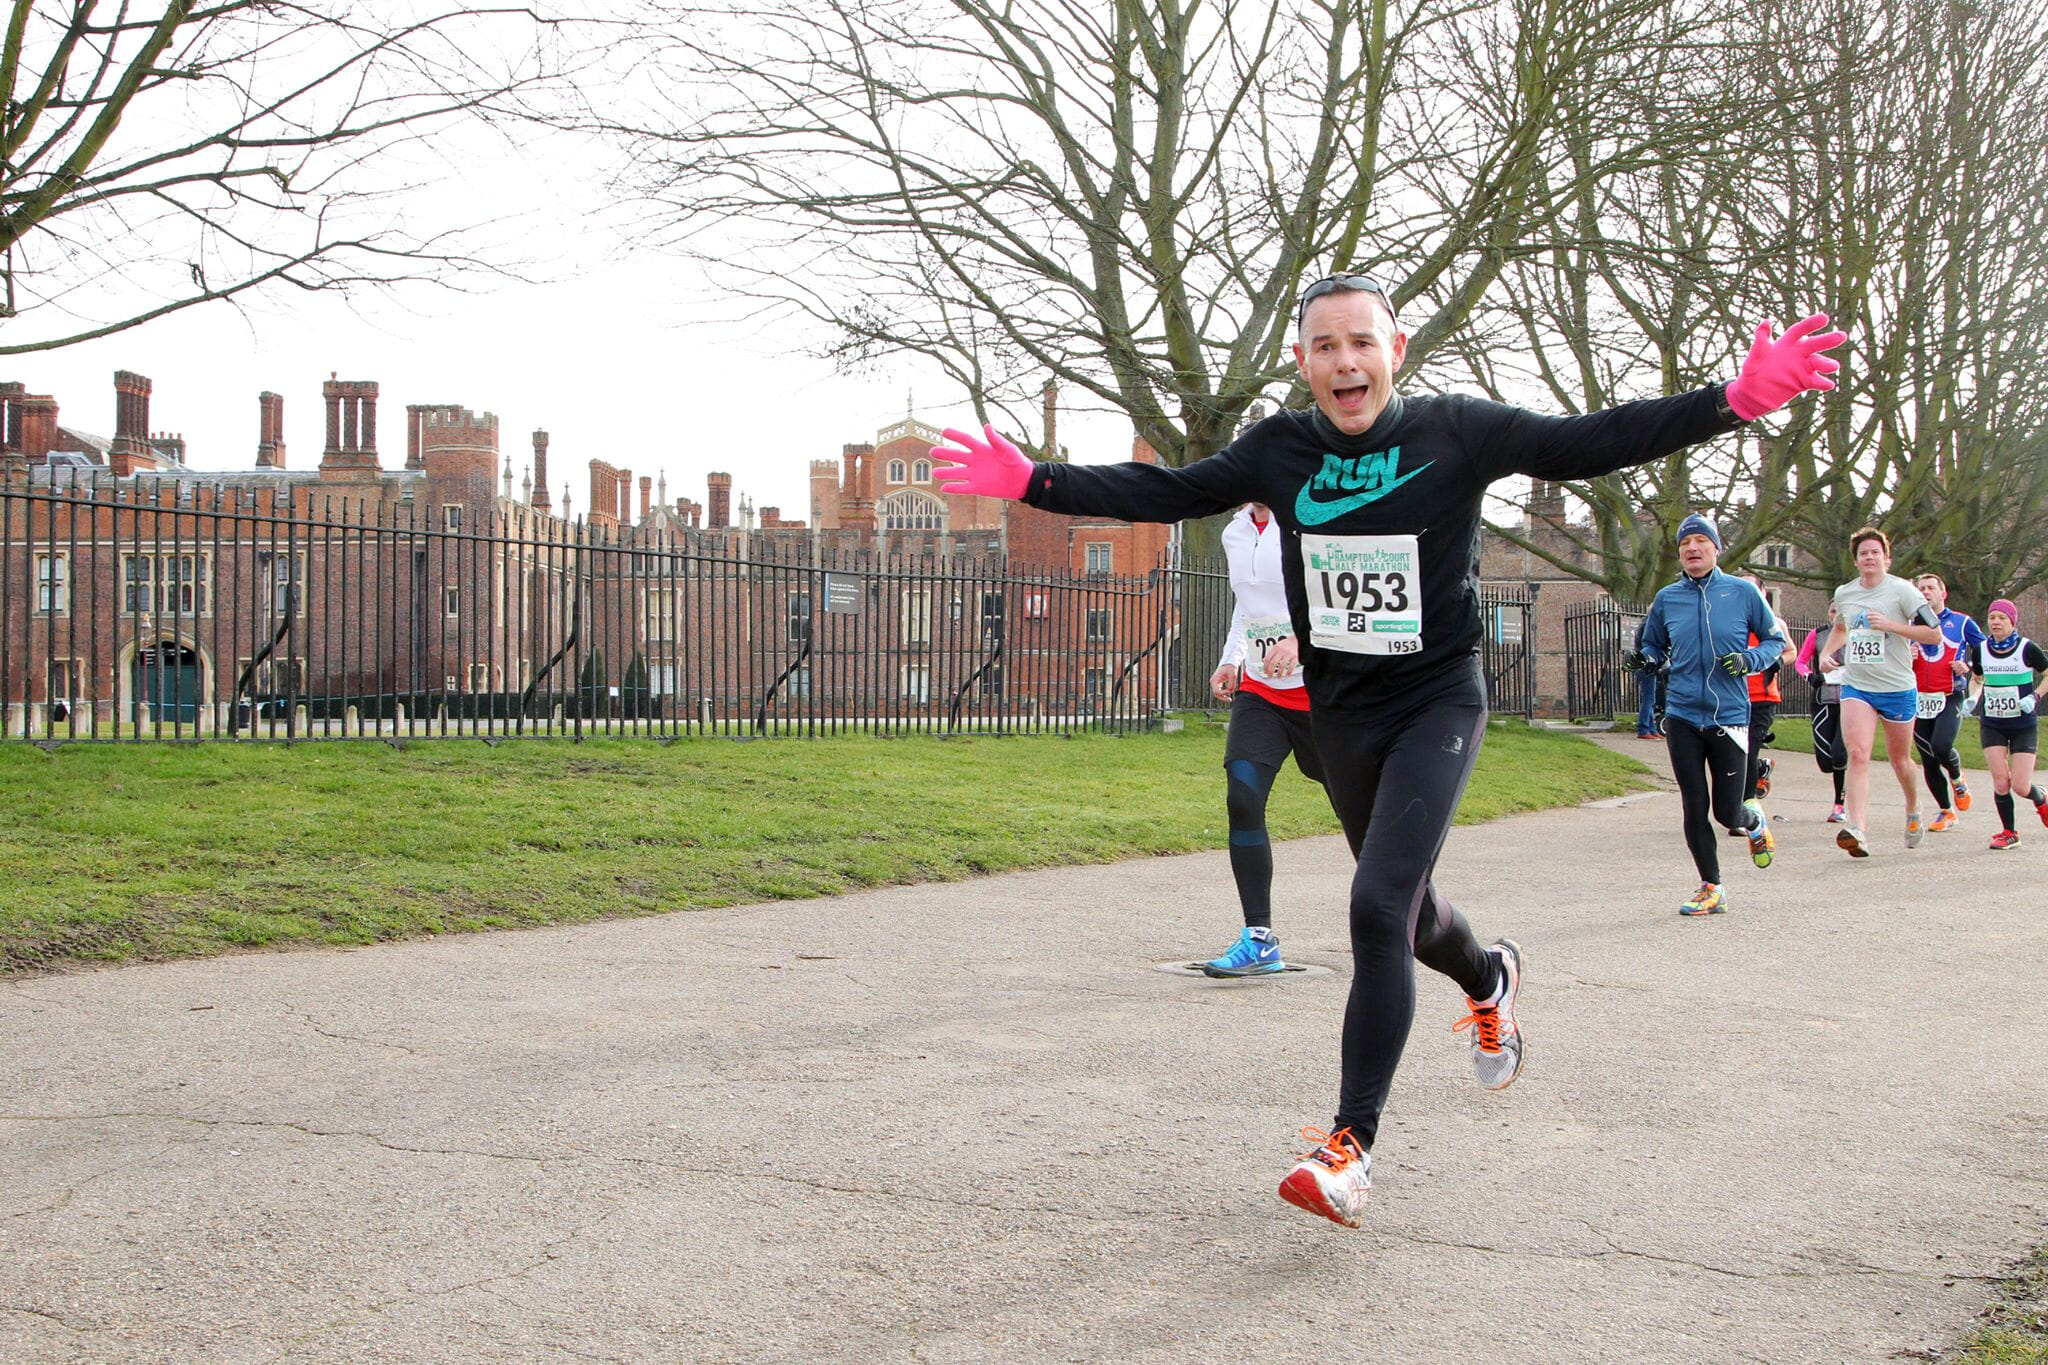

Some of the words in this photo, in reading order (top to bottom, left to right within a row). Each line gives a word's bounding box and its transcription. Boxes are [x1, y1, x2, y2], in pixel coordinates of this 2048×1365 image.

[1313, 445, 1401, 490] RUN
[1335, 553, 1375, 562] HAMPTON
[1383, 553, 1411, 562] COURT
[1335, 562, 1356, 571] HALF
[1360, 561, 1410, 571] MARATHON
[1320, 572, 1409, 613] 1953
[1388, 641, 1417, 652] 1953
[1852, 641, 1880, 656] 2633
[1919, 700, 1943, 712] 3402
[1988, 698, 2016, 711] 3450
